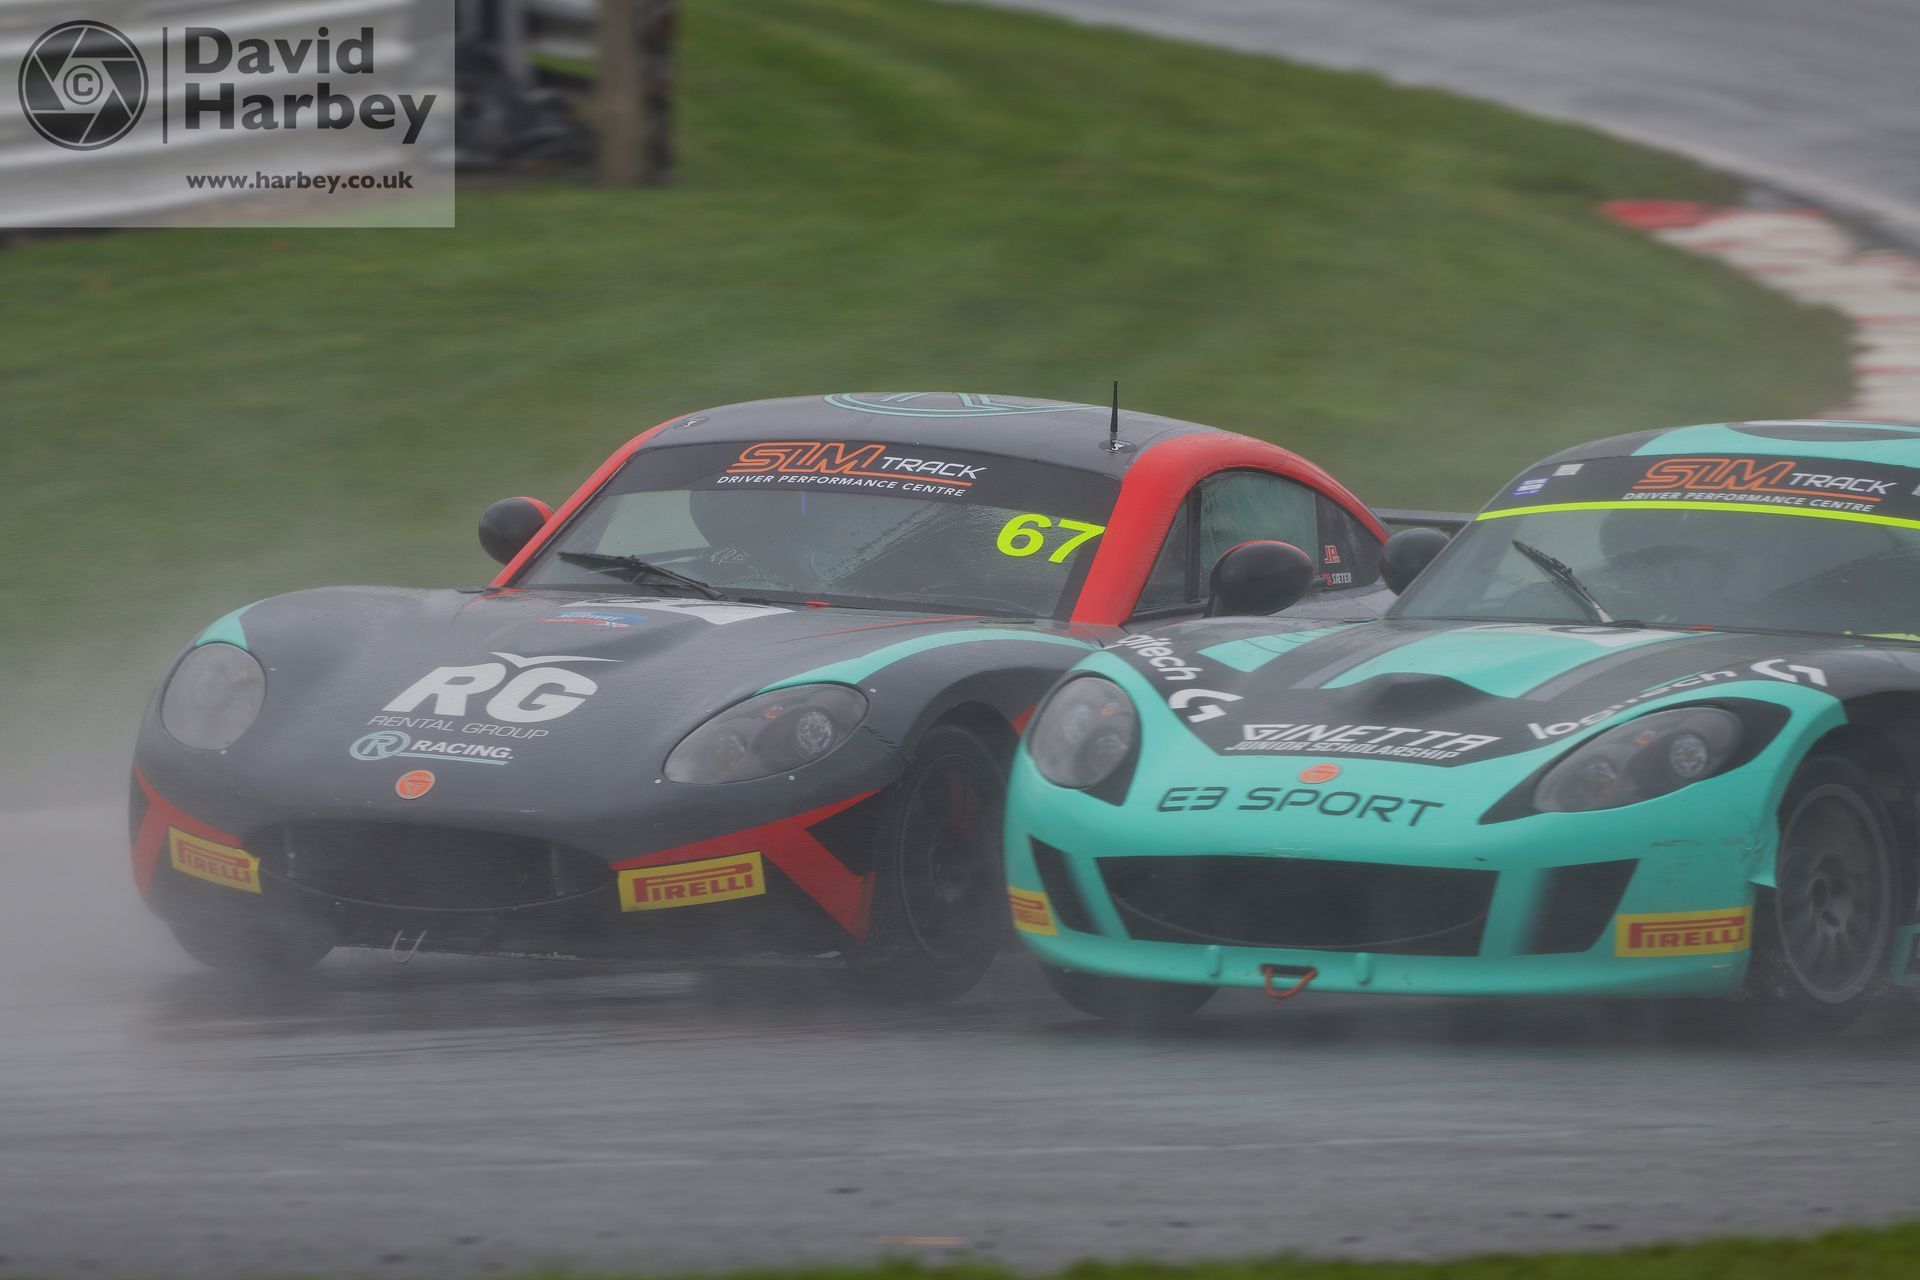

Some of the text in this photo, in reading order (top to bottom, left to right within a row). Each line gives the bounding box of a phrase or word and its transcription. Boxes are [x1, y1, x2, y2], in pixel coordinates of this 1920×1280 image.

[881, 456, 987, 480] TRACK
[717, 475, 966, 497] DRIVER PERFORMANCE CENTRE
[1792, 472, 1898, 495] TRACK
[1622, 491, 1875, 512] DRIVER PERFORMANCE CENTRE
[996, 513, 1105, 564] 67
[382, 662, 598, 723] RG
[367, 715, 550, 740] RENTAL GROUP
[1242, 723, 1502, 751] GINETTA
[1223, 741, 1461, 760] JUNIOR SCHOLARSHIP
[1237, 786, 1446, 827] SPORT
[176, 838, 252, 884] PIRELLI
[633, 862, 753, 903] PIRELLI
[1628, 906, 1745, 949] PIRELLI
